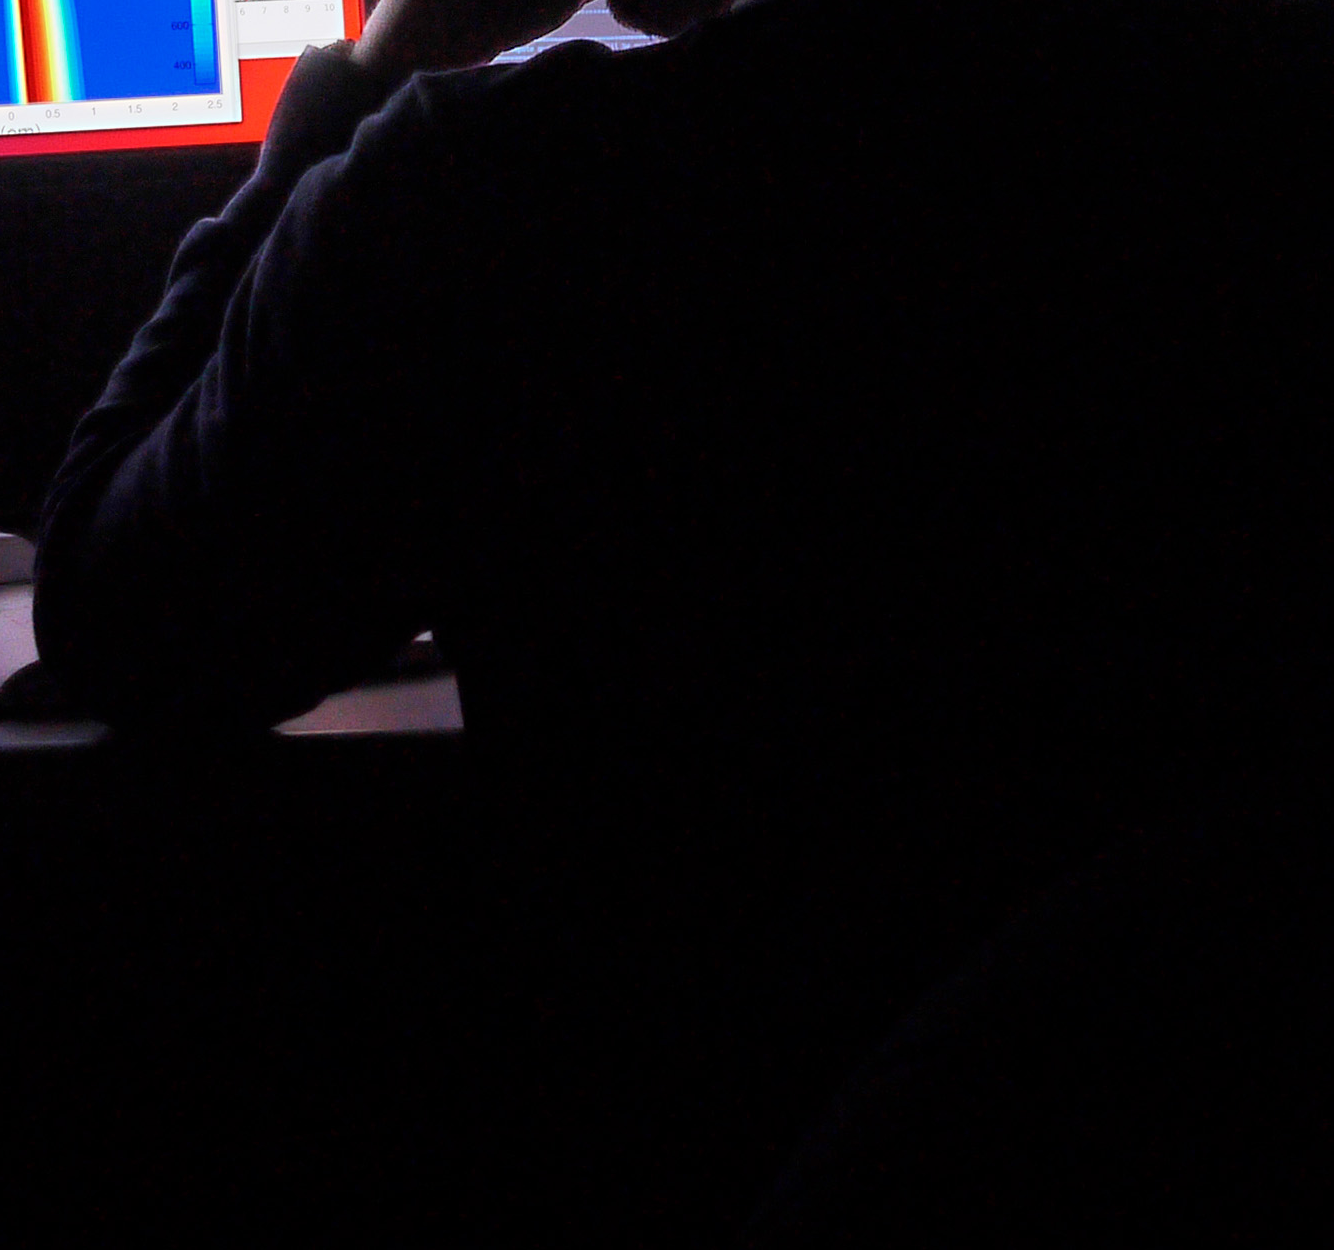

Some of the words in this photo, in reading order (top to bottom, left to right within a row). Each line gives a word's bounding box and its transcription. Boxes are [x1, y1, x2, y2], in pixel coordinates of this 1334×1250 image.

[325, 2, 336, 12] 10
[8, 111, 16, 121] 0
[44, 108, 62, 119] 0.5
[127, 104, 143, 114] 1.5
[171, 101, 179, 111] 2
[207, 99, 223, 110] 2.5
